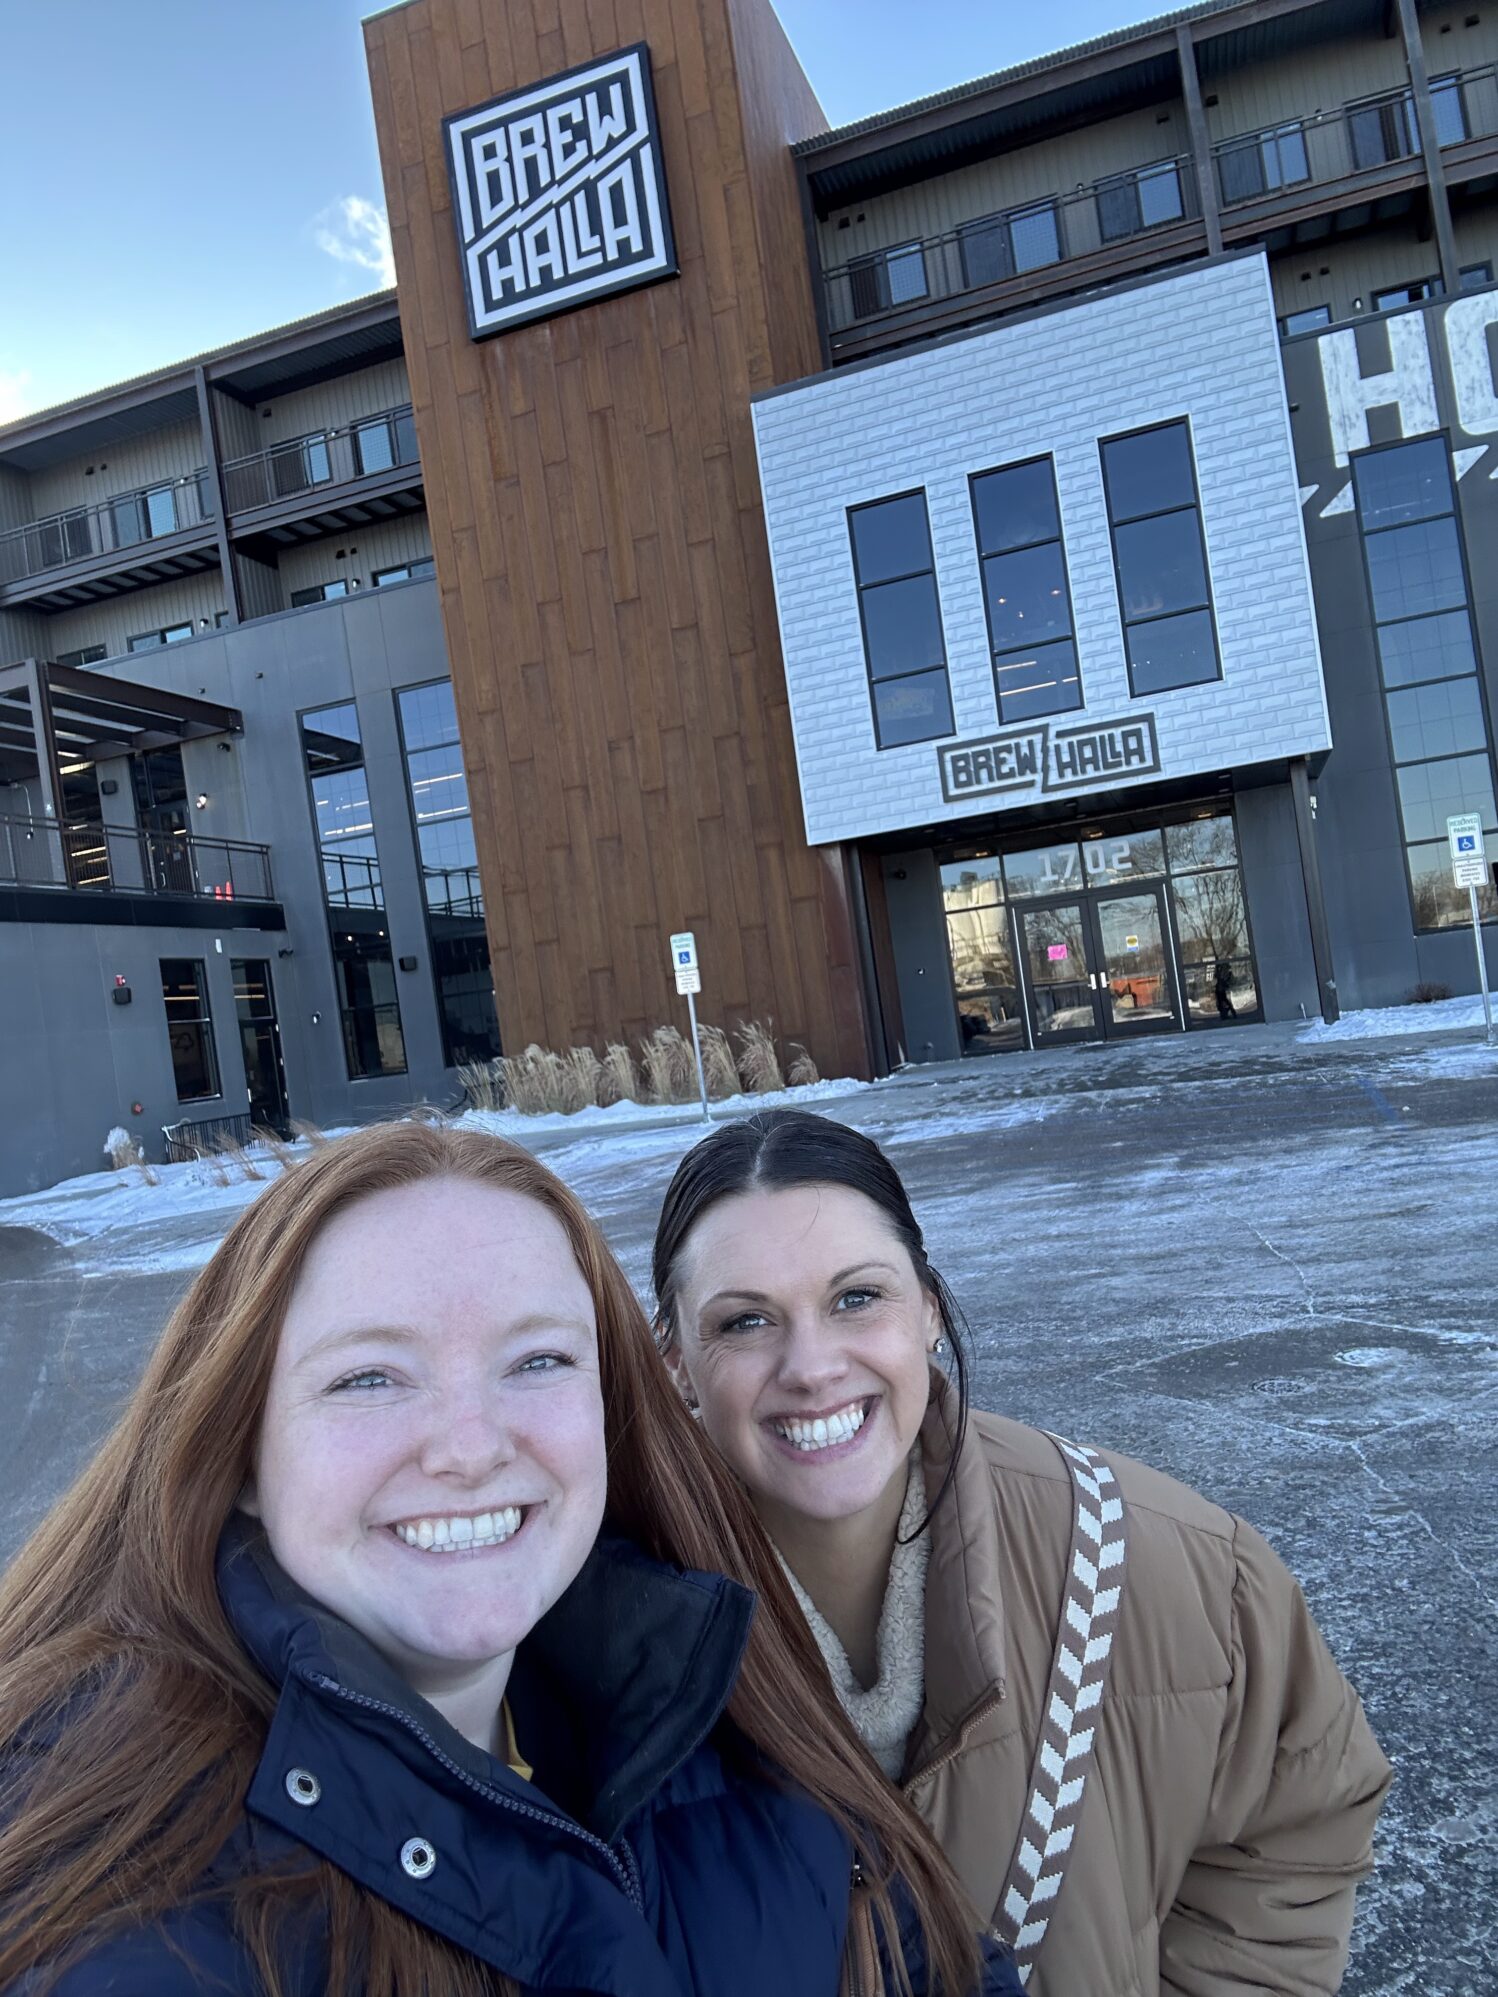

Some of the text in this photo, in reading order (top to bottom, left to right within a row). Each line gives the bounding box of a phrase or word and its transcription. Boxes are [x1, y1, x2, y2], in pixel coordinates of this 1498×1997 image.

[471, 82, 627, 229] BREW
[486, 157, 643, 301] HALLA
[950, 727, 1146, 789] BREW HALLA
[1038, 840, 1132, 882] 1702
